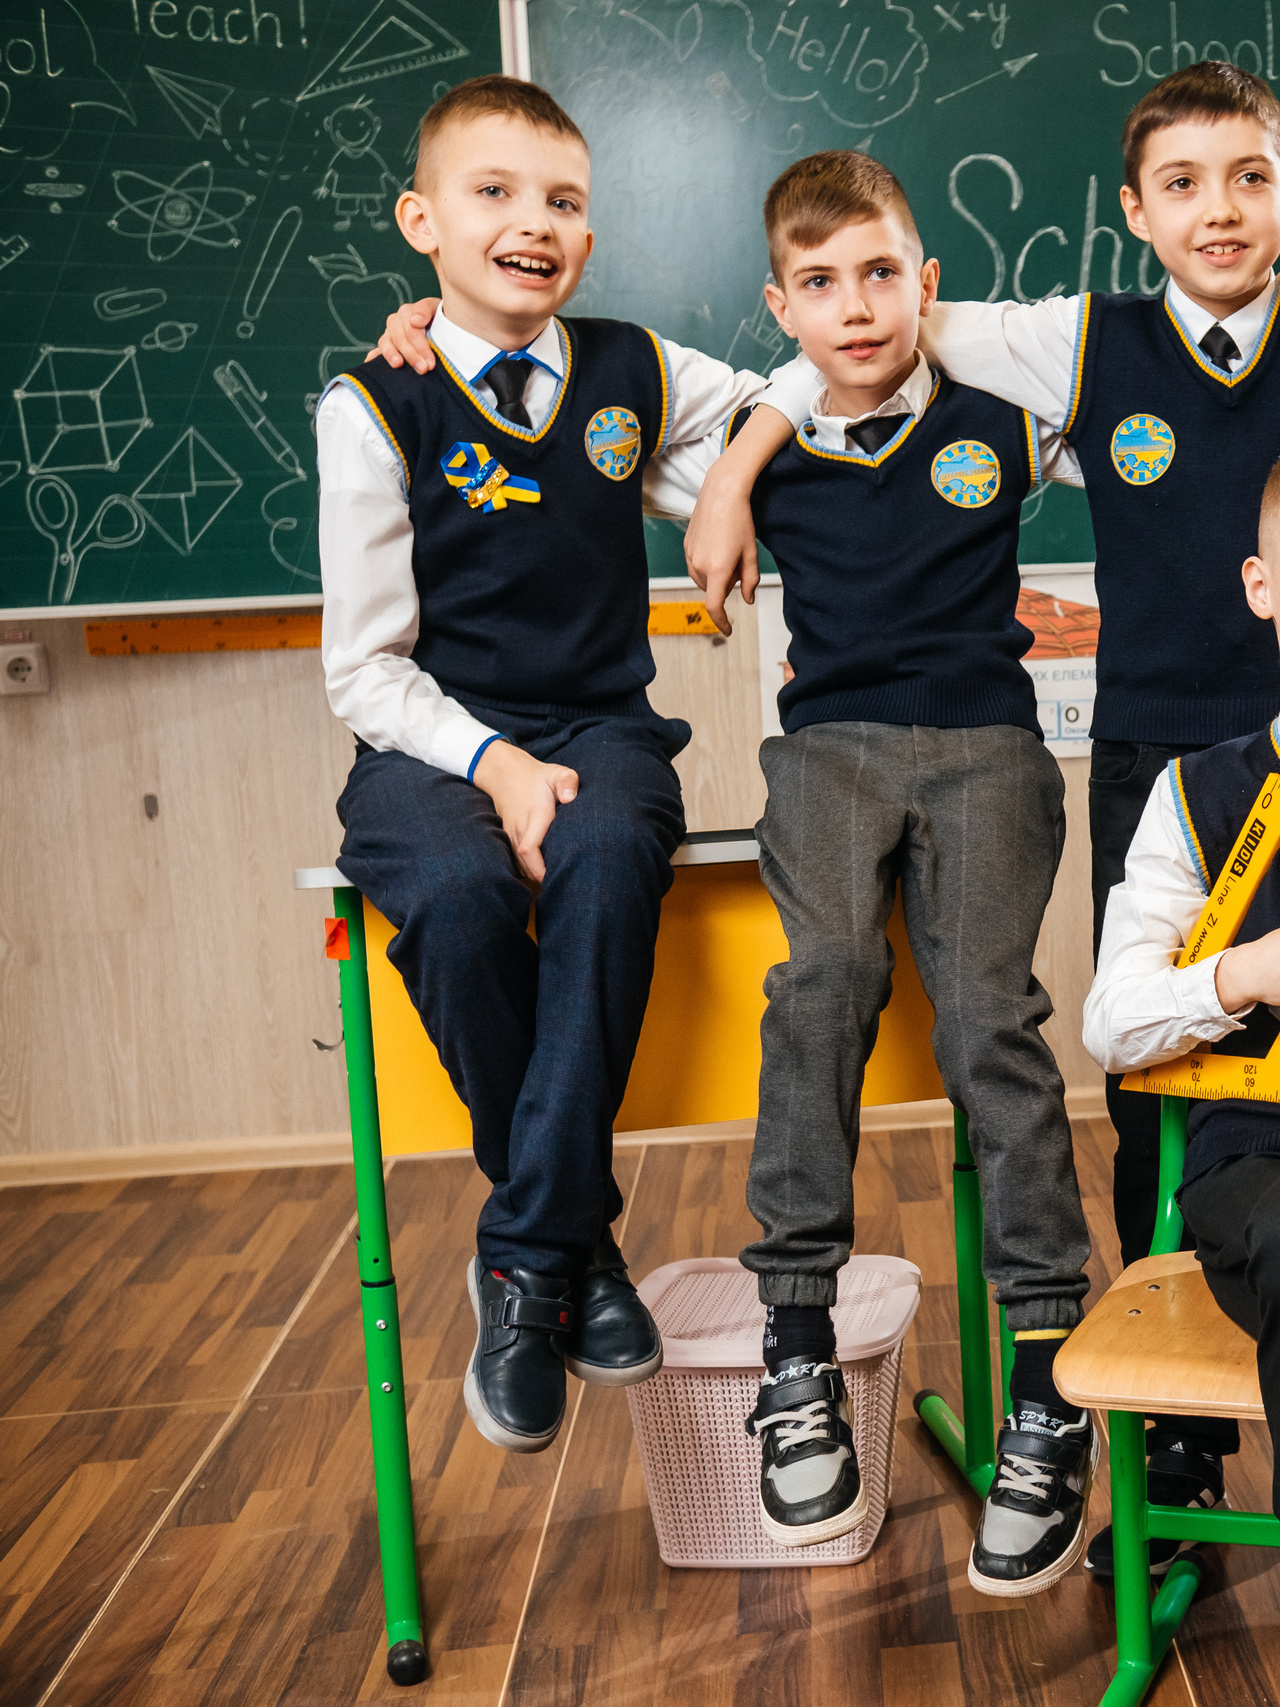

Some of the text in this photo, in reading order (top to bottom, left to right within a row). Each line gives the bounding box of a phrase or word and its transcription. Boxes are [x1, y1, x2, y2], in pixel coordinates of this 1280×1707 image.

[767, 10, 920, 101] Hello!
[1261, 792, 1273, 809] 0
[1217, 818, 1267, 905] KIDS Line
[1190, 1059, 1203, 1069] 140
[1243, 1064, 1257, 1075] 120
[1191, 1072, 1201, 1082] 70
[1245, 1078, 1255, 1088] 60
